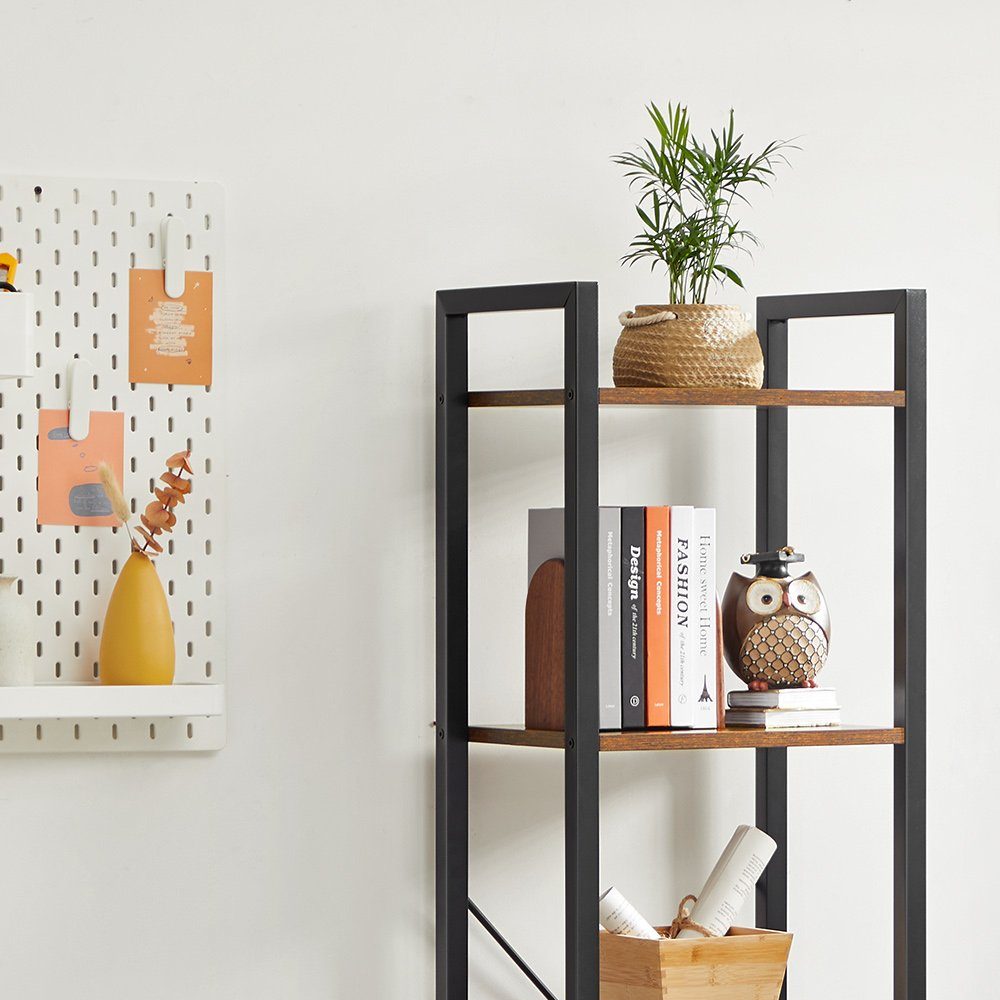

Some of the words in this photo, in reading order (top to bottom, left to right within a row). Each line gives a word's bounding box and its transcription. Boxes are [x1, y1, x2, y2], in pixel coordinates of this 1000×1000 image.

[628, 545, 642, 600] Design
[655, 530, 663, 578] Metaphorical
[699, 535, 711, 574] Home
[655, 581, 663, 615] Concepts
[677, 537, 689, 628] FASHION
[699, 579, 709, 612] sweet
[699, 616, 711, 657] Home
